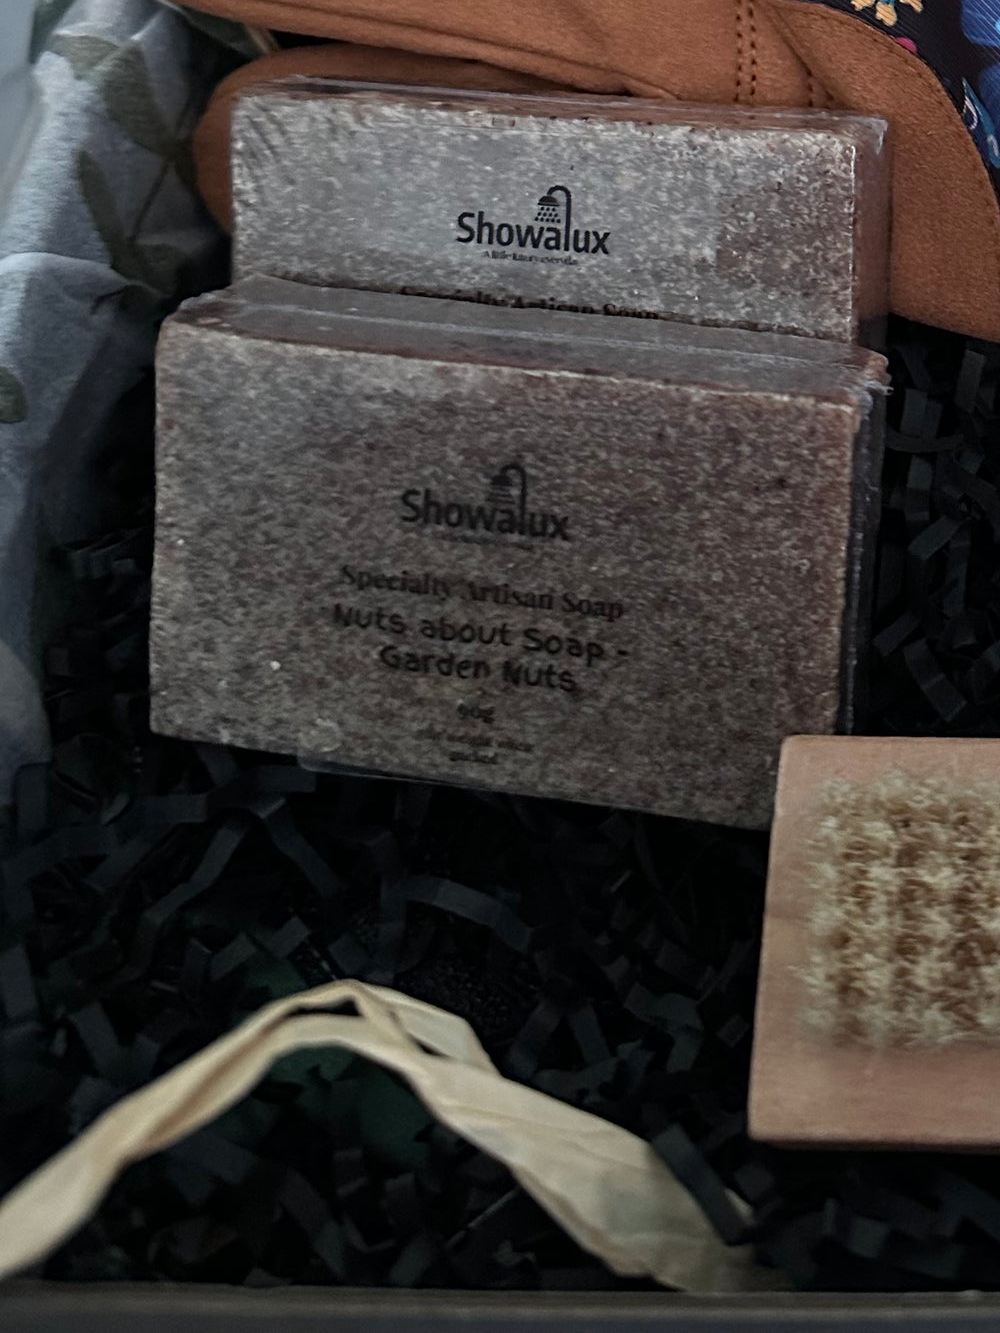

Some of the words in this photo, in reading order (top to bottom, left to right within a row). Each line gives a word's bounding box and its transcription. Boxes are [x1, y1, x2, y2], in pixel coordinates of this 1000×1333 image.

[456, 194, 611, 255] Showalux
[401, 474, 569, 541] Showalux
[341, 565, 453, 602] Specialty
[459, 581, 554, 611] Artisan
[562, 592, 625, 623] Soap
[333, 604, 406, 635] Nuts
[419, 617, 512, 647] about
[522, 627, 605, 666] Soap
[379, 644, 492, 680] Garden
[503, 658, 579, 693] Nuts
